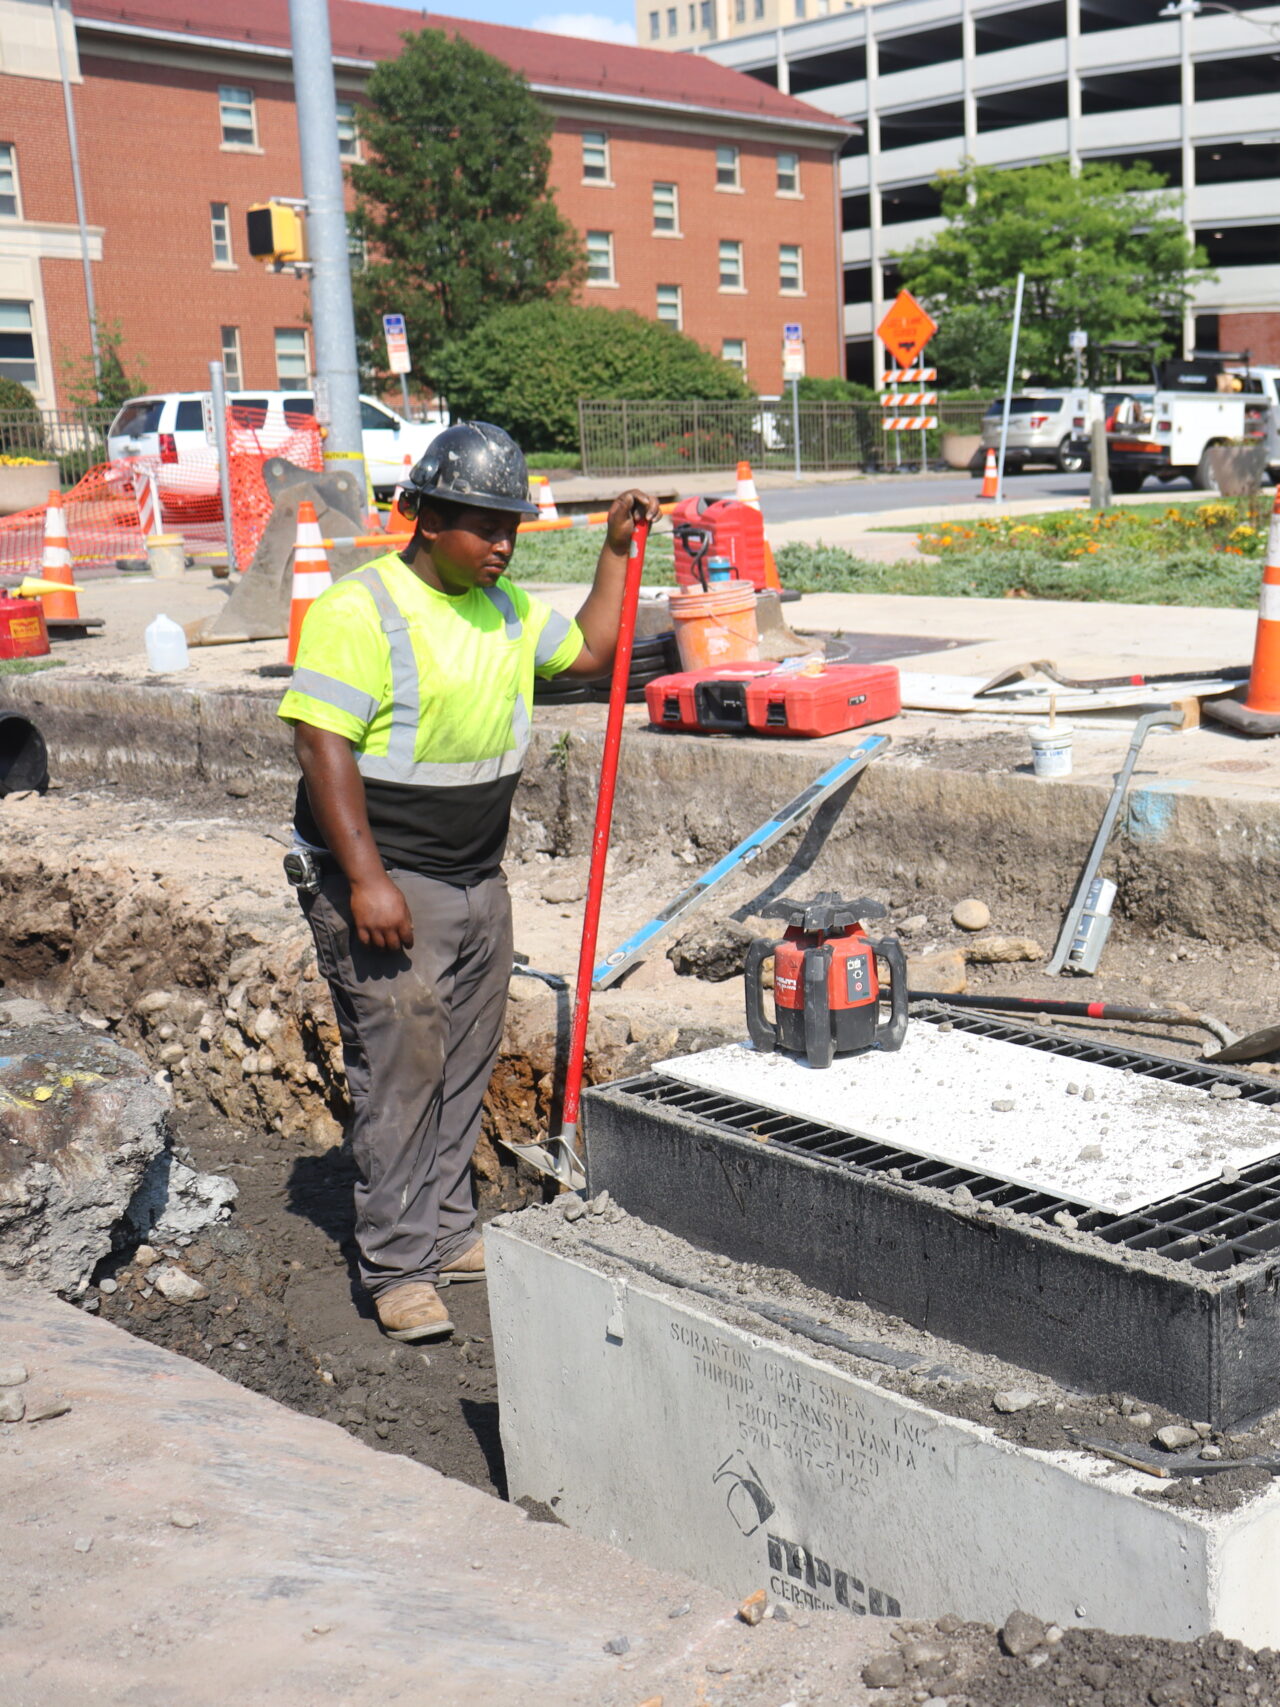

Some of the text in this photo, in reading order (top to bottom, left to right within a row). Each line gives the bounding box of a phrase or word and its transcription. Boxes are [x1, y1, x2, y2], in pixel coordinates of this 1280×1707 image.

[670, 1322, 751, 1370] SCRANTON
[893, 1417, 937, 1453] INC.
[777, 1391, 917, 1471] PENNSYLVANIA
